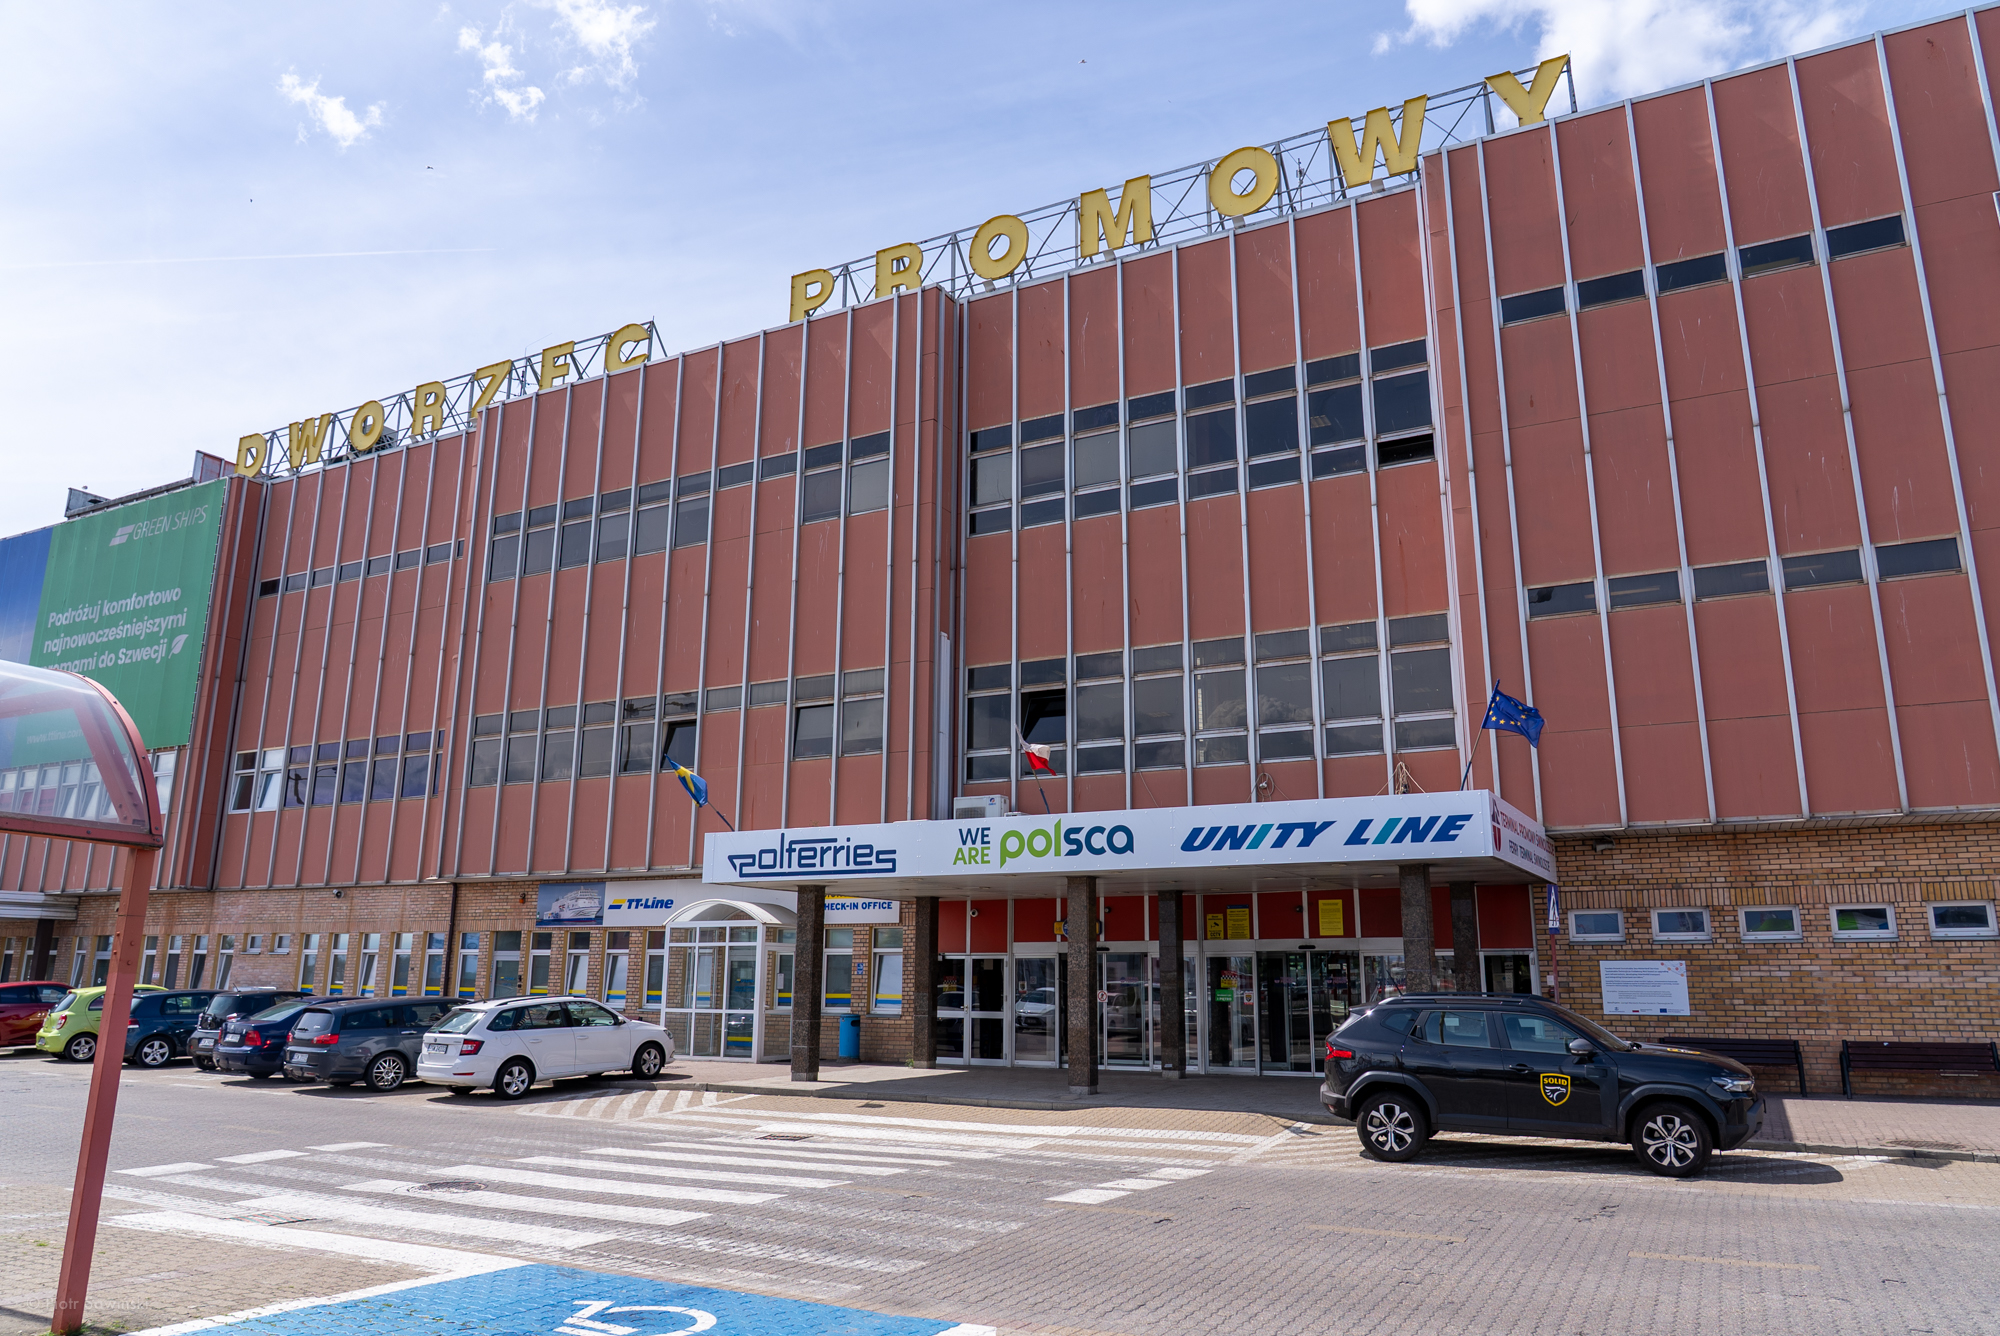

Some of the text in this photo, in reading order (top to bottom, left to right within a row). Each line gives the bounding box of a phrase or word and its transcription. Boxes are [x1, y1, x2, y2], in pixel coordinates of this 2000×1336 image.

[790, 54, 1569, 322] PROMOWY
[234, 323, 651, 478] DWORZEC
[133, 505, 208, 540] GREEN SHIPS
[48, 588, 181, 628] Podróżuj komfortowo
[43, 607, 187, 656] najnowocześniejszymi
[98, 651, 115, 668] do
[118, 638, 167, 664] Szwecji
[958, 826, 991, 846] WE
[1180, 814, 1473, 852] UNITY LINE
[1500, 811, 1519, 835] TERMINAL
[728, 833, 897, 878] polferries
[953, 847, 991, 866] ARE
[1000, 818, 1135, 869] polsca
[627, 897, 674, 910] TT-Line
[824, 901, 893, 911] HECK-IN OFFICE
[1543, 1077, 1567, 1086] SOLID
